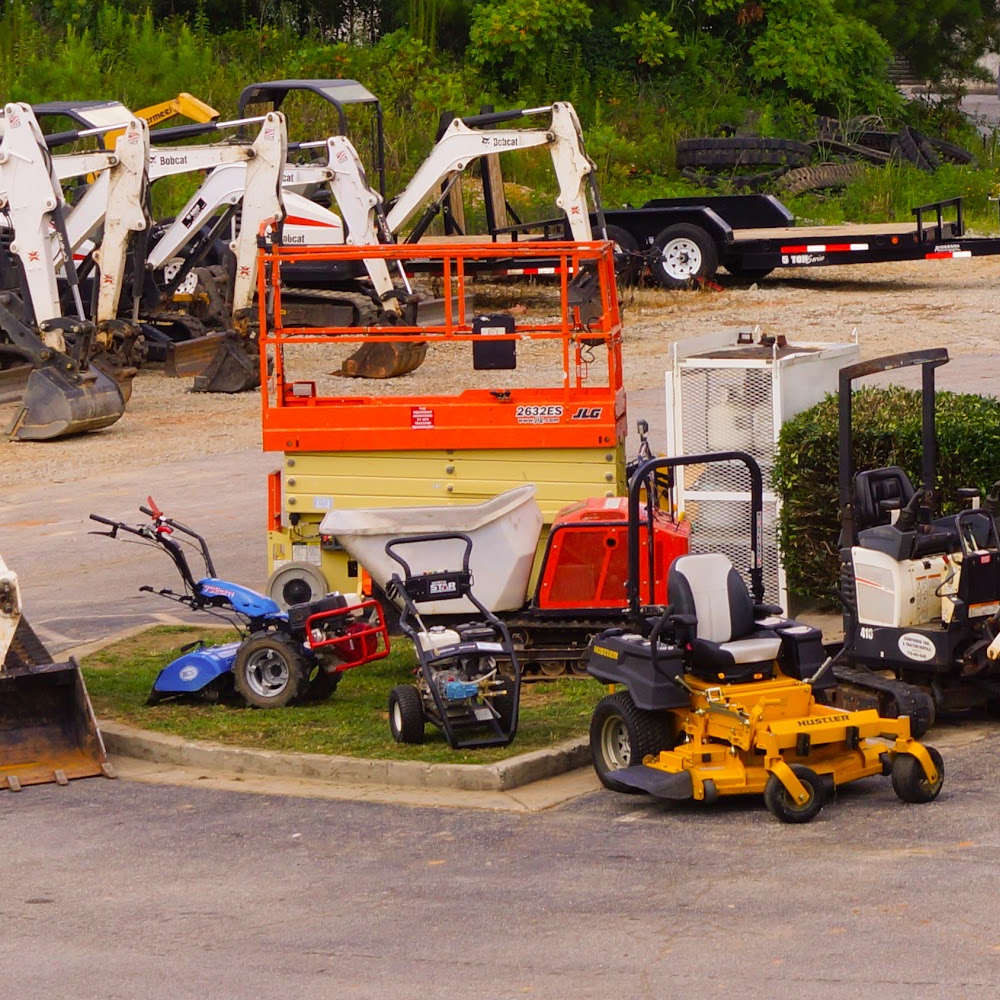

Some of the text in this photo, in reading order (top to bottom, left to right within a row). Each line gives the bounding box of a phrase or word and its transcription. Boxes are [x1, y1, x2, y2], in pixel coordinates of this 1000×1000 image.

[146, 105, 173, 125] ermeer
[160, 155, 188, 166] Bobcat
[283, 234, 305, 244] obcat
[781, 255, 790, 264] 5
[516, 406, 563, 416] 2632ES
[572, 408, 602, 419] JLG
[797, 714, 850, 727] HUSTLER
